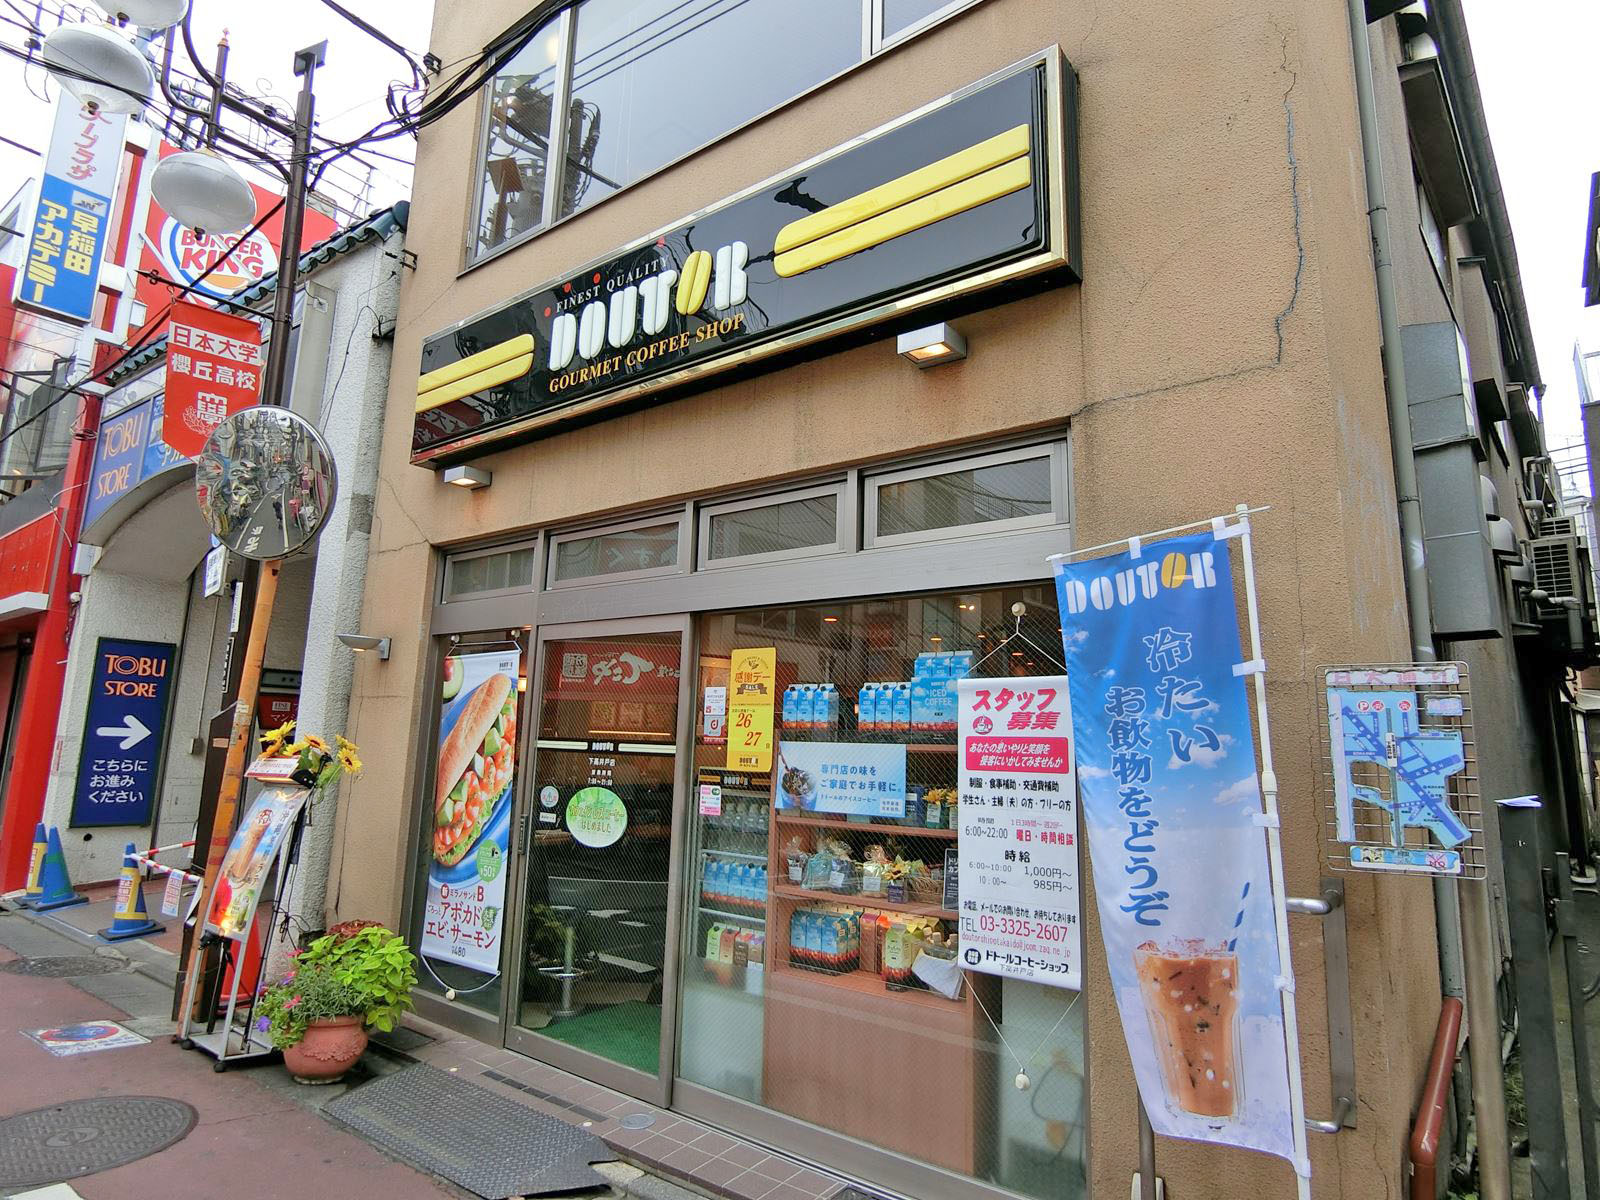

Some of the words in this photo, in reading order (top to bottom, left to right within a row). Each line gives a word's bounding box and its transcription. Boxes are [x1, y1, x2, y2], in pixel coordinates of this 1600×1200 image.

[28, 199, 68, 303] アカデミー
[64, 210, 99, 276] 早稲田
[181, 230, 263, 258] BURGER
[180, 248, 264, 278] KING
[555, 285, 601, 314] FINEST
[605, 257, 669, 292] QUALITY
[549, 240, 749, 371] DOUTOR
[173, 325, 259, 362] 日本大学
[549, 356, 622, 393] GOURMET
[626, 331, 690, 366] COFFEE
[695, 313, 745, 343] SHOP
[171, 352, 256, 391] 櫻丘高校
[103, 412, 144, 460] TOBU
[96, 463, 132, 500] STORE
[1065, 551, 1217, 614] DOUTOR
[105, 654, 167, 677] TOBU
[735, 671, 771, 683] 感謝デー
[104, 680, 158, 698] STORE
[925, 697, 953, 706] COFFEE
[929, 688, 947, 698] ICED
[972, 687, 1057, 712] スタッフ
[1142, 626, 1221, 763] 冷たい
[736, 712, 753, 728] 26
[1007, 711, 1061, 731] 募集
[744, 731, 762, 747] 27
[969, 742, 1051, 755] あなたの思いやりと笑顔を
[92, 759, 148, 772] こちらに
[821, 764, 878, 776] 専門店の味を
[980, 756, 1063, 768] 接客にいかしてみませんか
[90, 774, 135, 788] お進み
[820, 779, 902, 792] ご家庭でお手軽に。
[88, 790, 144, 803] ください
[1105, 685, 1169, 927] お飲物をどうぞ
[1004, 849, 1031, 863] 時給
[441, 901, 483, 926] アボカド
[426, 921, 496, 949] エビ・サーモン
[960, 916, 978, 932] TEL
[980, 915, 1068, 943] 03-3325-2607
[986, 950, 1069, 973] ドトールコーヒーショップ
